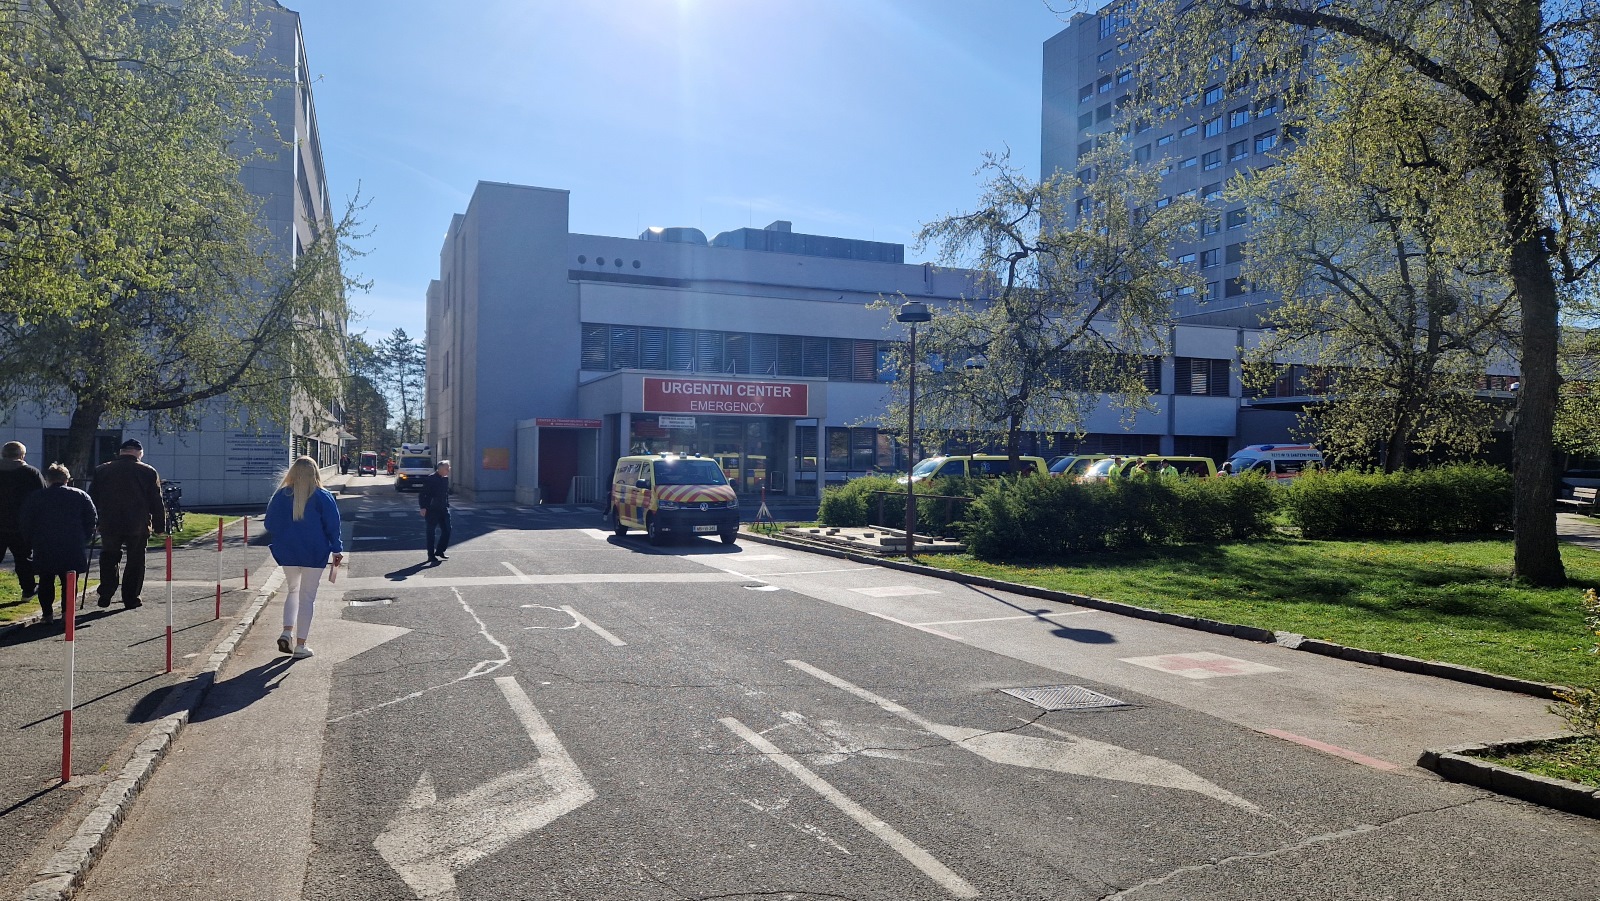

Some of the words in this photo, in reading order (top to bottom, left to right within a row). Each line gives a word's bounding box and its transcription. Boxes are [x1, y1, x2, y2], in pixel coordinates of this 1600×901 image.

[661, 381, 733, 396] URGENTNI
[736, 384, 792, 398] CENTER
[690, 400, 765, 412] EMERGENCY
